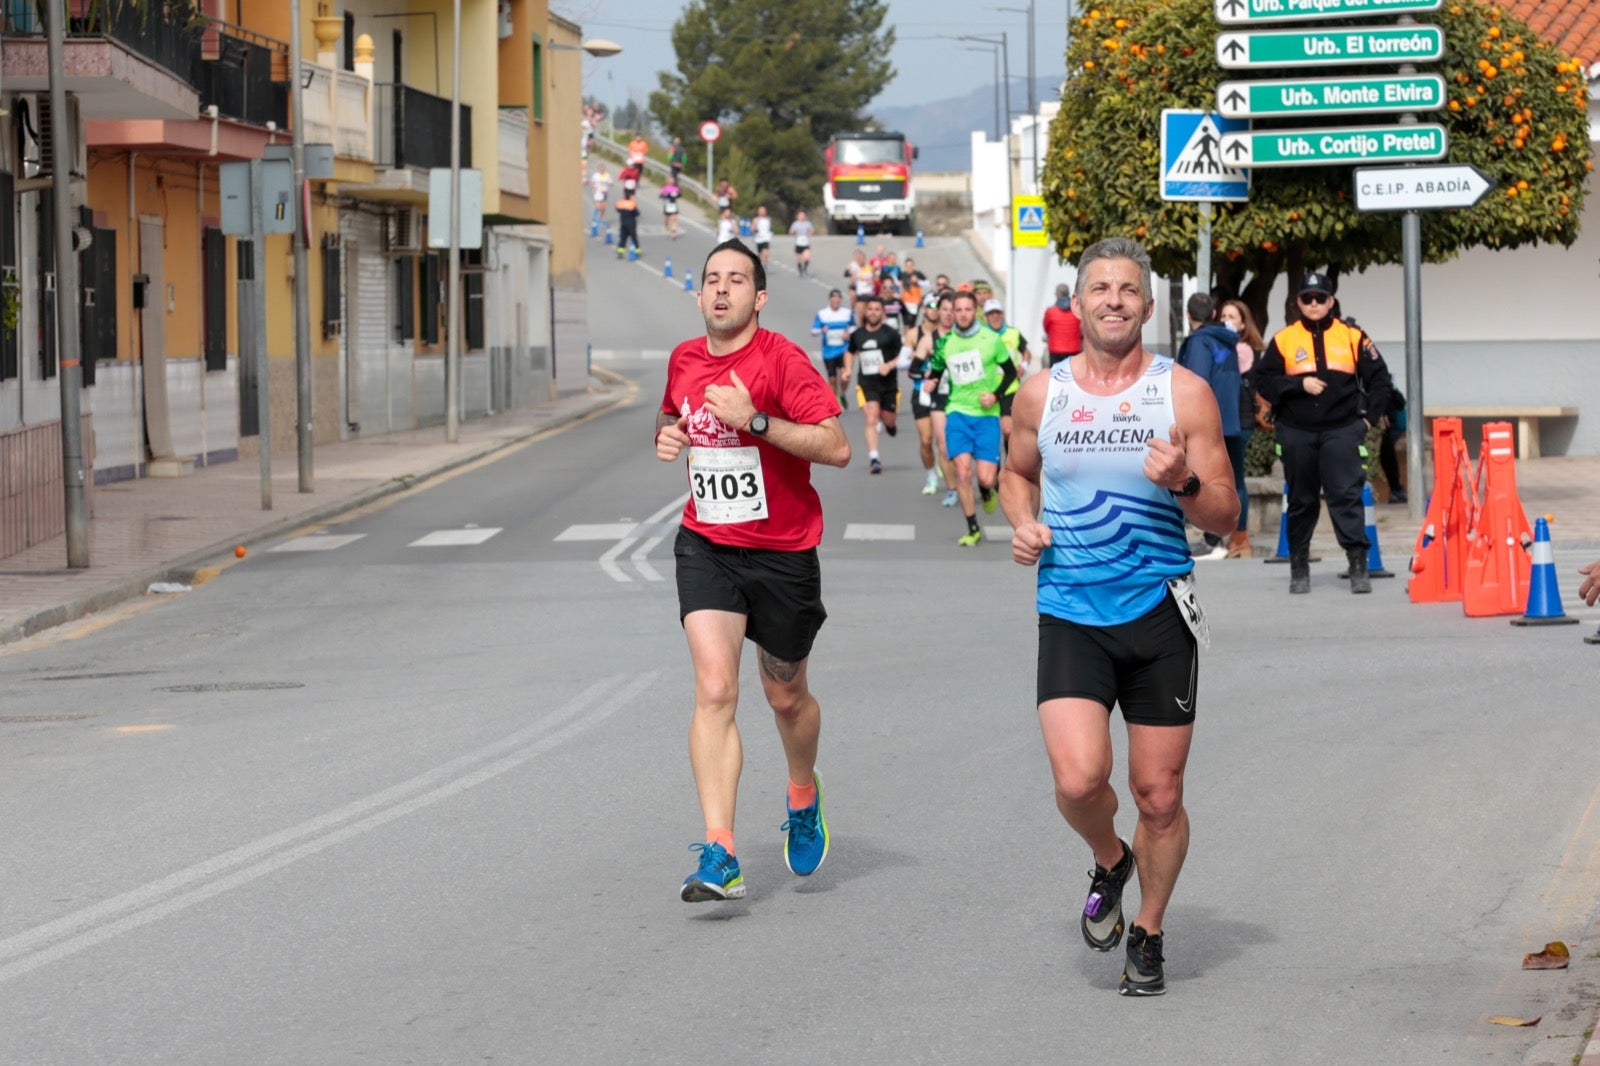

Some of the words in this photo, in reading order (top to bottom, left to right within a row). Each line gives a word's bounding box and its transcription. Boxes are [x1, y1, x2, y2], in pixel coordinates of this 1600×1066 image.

[1303, 37, 1341, 55] Urb.
[1346, 36, 1363, 53] El
[1368, 34, 1432, 52] torreón
[1281, 87, 1318, 106] Urb.
[1323, 86, 1379, 105] Monte
[1384, 84, 1433, 102] Elvira
[1277, 138, 1315, 156] Urb.
[1320, 135, 1378, 156] Cortijo
[1383, 133, 1436, 151] Pretel
[1361, 183, 1408, 195] C.E.I.P.
[1415, 179, 1471, 193] ABADÍA
[954, 360, 976, 373] 781
[1054, 428, 1154, 445] MARACENA
[693, 472, 759, 500] 3103
